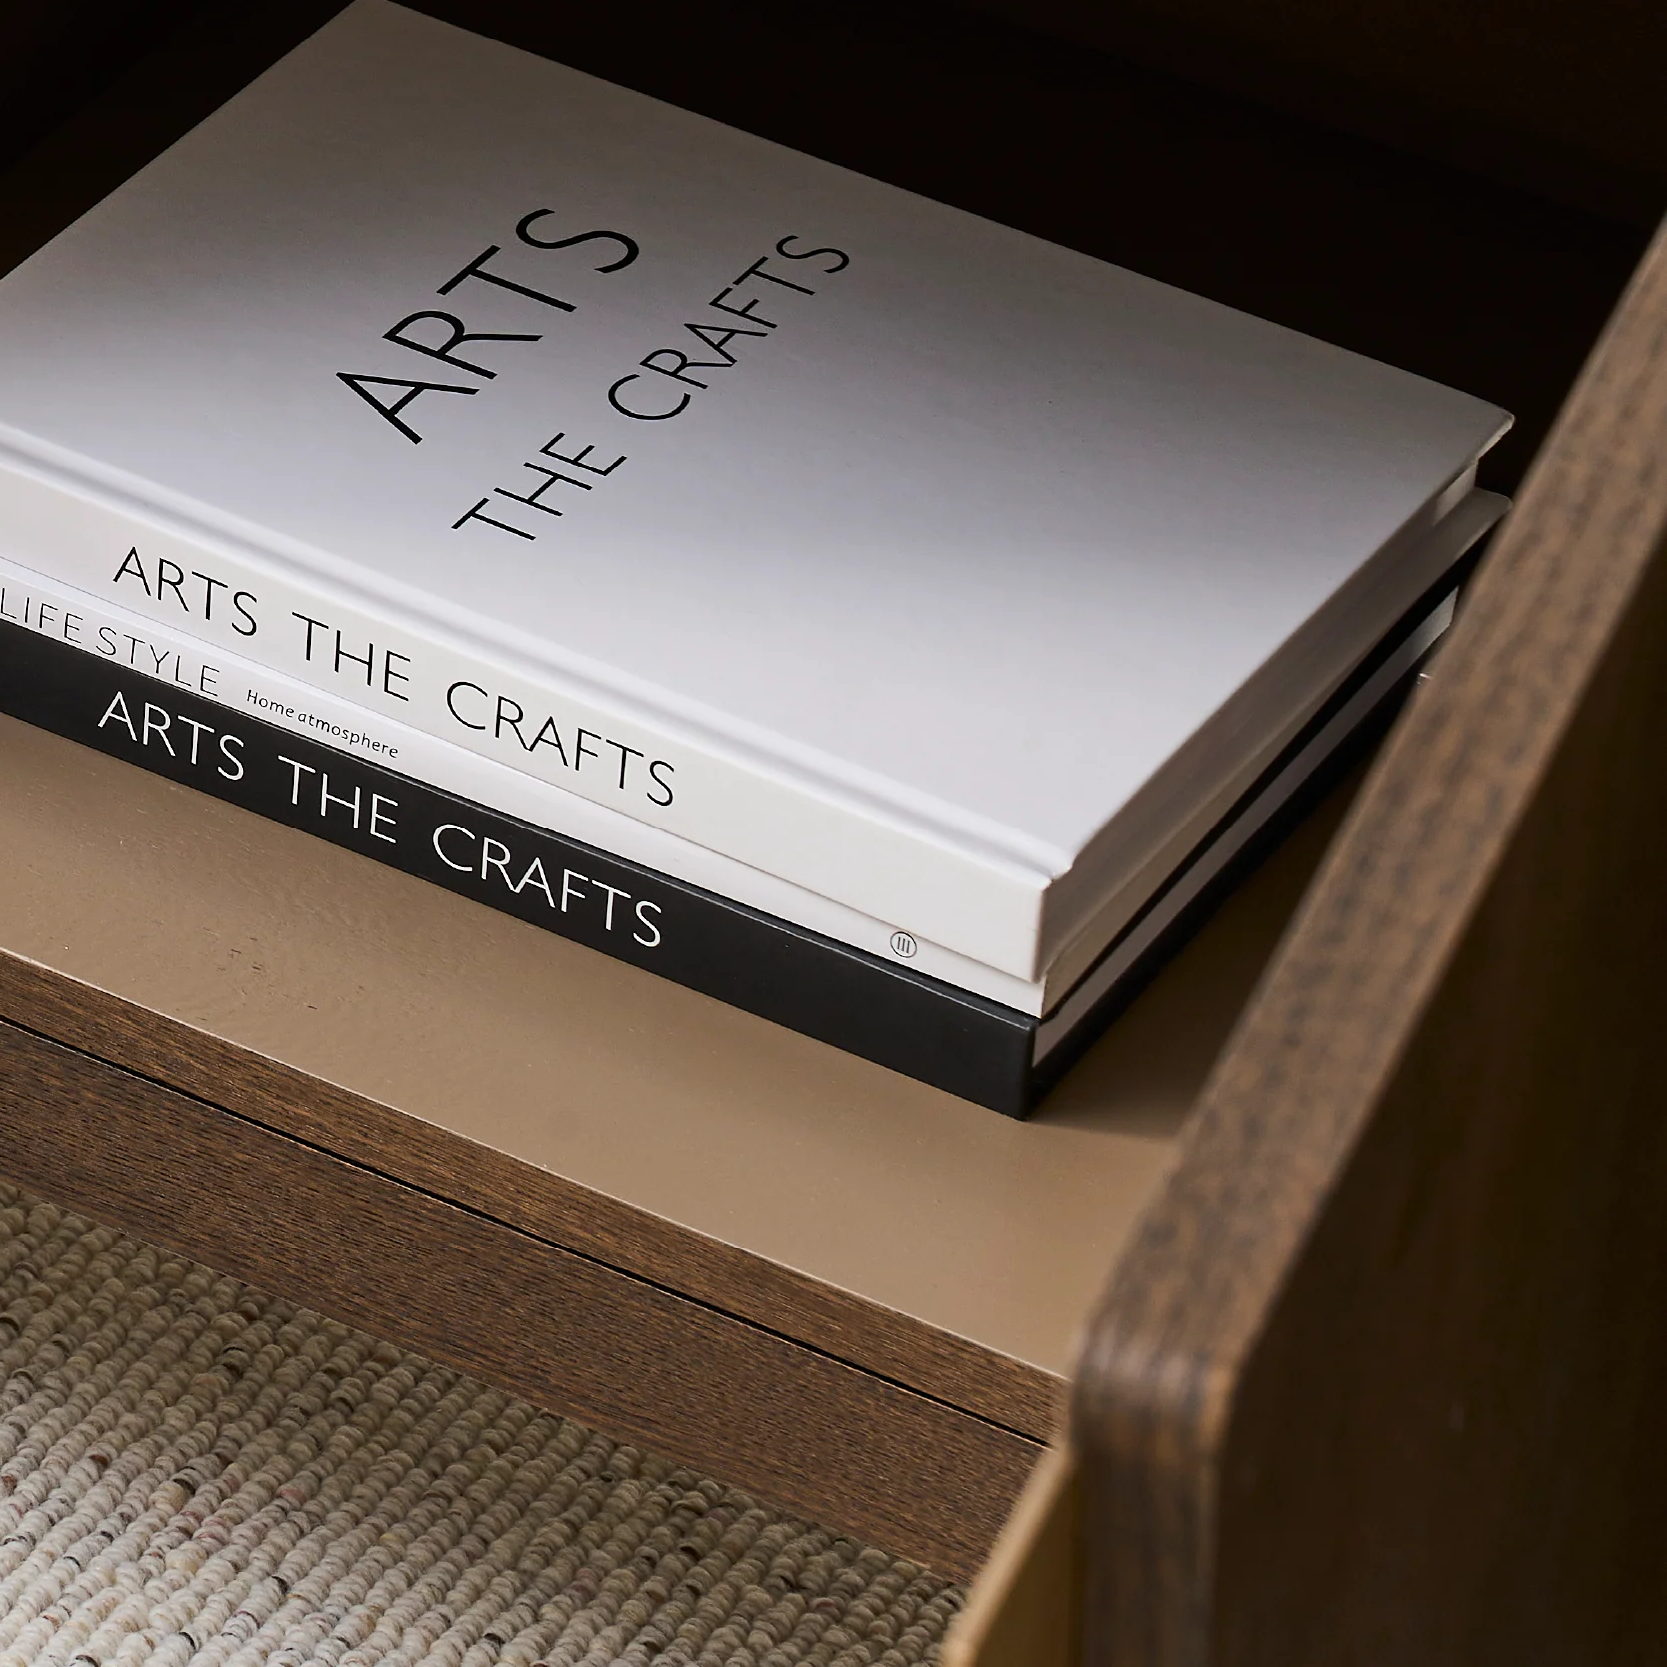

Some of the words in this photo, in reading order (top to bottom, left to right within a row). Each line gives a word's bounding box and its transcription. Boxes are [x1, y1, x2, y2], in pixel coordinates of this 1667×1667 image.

[338, 209, 639, 444] ARTS
[451, 432, 625, 541] THE
[609, 236, 849, 420] CRAFTS
[113, 547, 257, 636] ARTS
[292, 612, 410, 701] THE
[447, 682, 674, 806] CRAFTS
[247, 690, 294, 717] Home
[298, 714, 398, 758] atmosphere
[98, 692, 244, 780] ARTS
[278, 755, 398, 843] THE
[433, 824, 661, 947] CRAFTS
